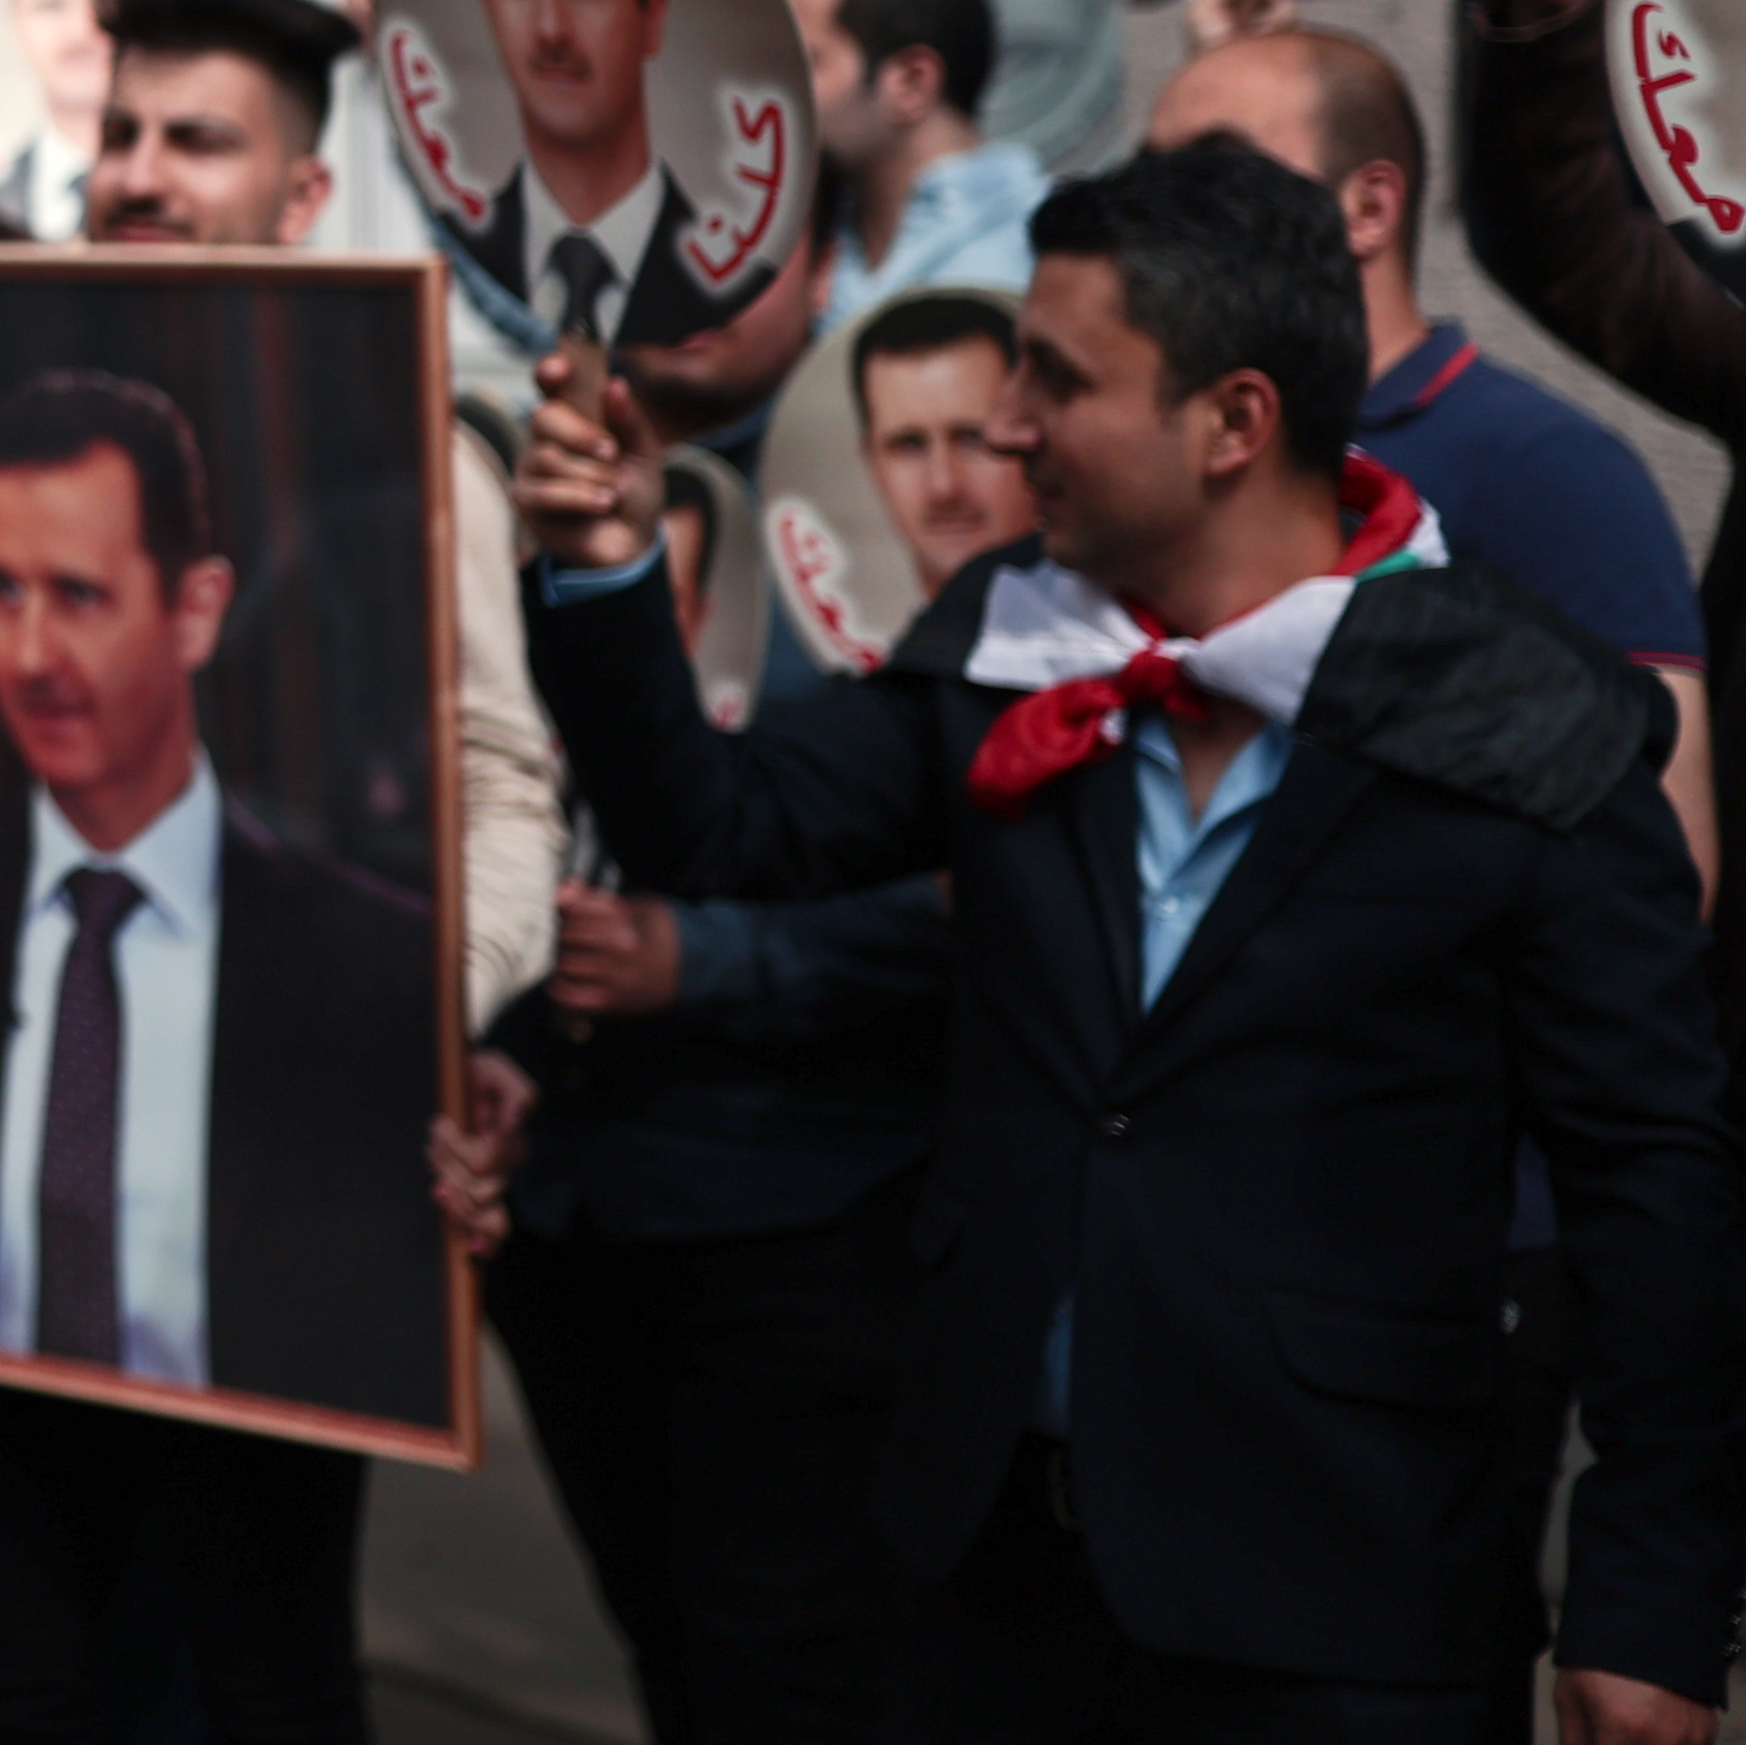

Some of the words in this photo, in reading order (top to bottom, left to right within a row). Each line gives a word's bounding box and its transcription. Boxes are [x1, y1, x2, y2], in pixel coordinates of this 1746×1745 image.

[391, 32, 485, 221] معك
[688, 101, 785, 282] كلنا
[1632, 1, 1745, 232] معك
